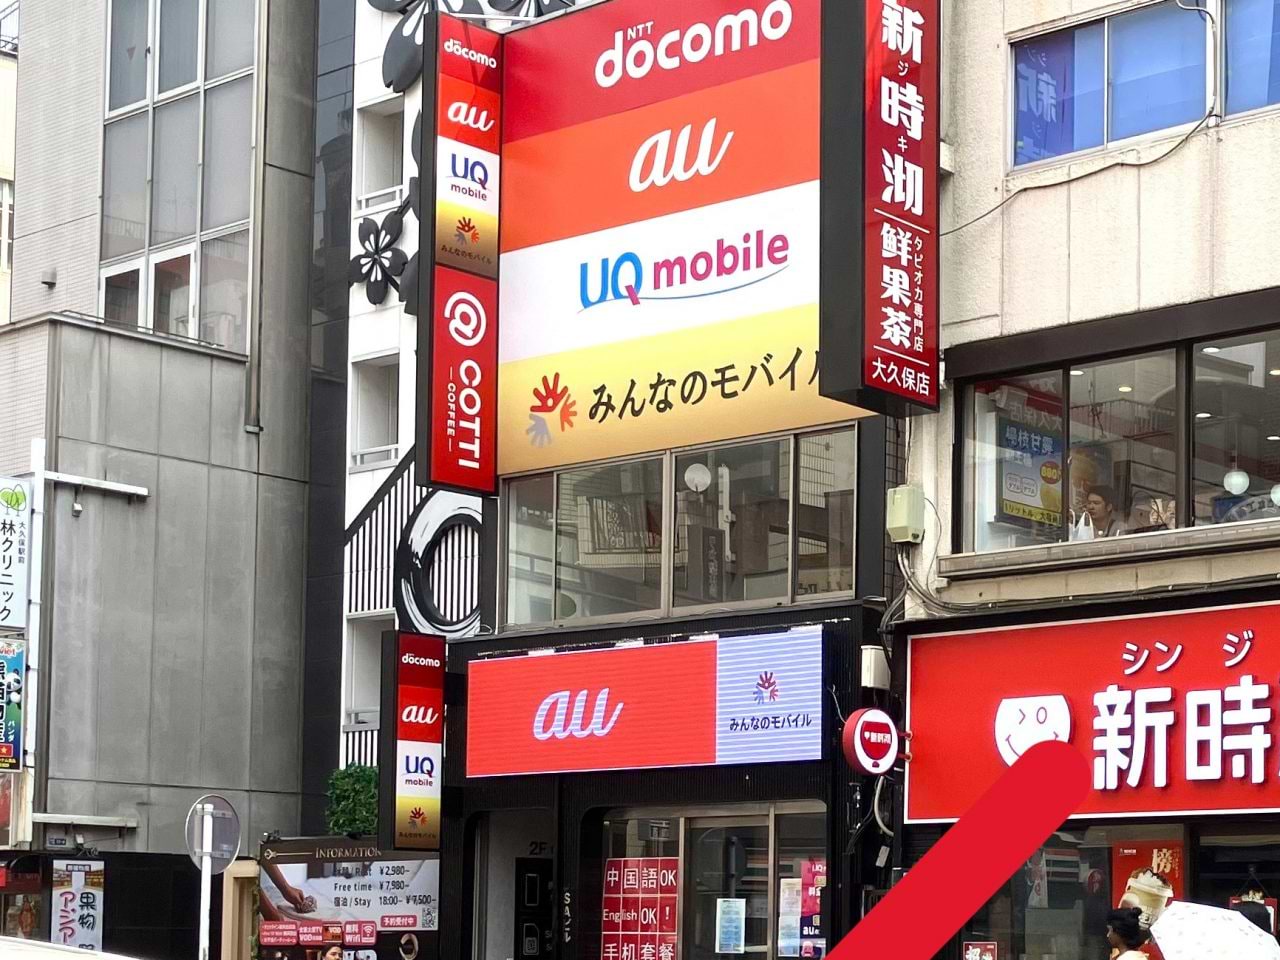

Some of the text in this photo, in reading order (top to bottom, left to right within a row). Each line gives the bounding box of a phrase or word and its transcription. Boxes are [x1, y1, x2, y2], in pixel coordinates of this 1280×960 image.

[594, 0, 793, 88] docomo
[627, 20, 654, 41] NTT
[444, 38, 497, 69] docomo
[447, 100, 495, 132] au
[628, 117, 734, 193] au
[451, 153, 489, 190] UQ
[450, 183, 487, 202] mobile
[579, 230, 789, 307] UQ mobile
[880, 222, 913, 350] 鮮果茶
[912, 235, 925, 354] タピオカ専門店
[872, 355, 931, 397] 大久保店
[447, 383, 457, 437] COFFEE
[459, 359, 482, 469] COTTI
[0, 519, 16, 621] 林クリニック
[401, 653, 441, 667] docomo
[1122, 641, 1183, 675] シン
[1222, 629, 1254, 667] ジ
[402, 705, 439, 724] au
[532, 687, 625, 741] au
[729, 713, 812, 732] みんなのモバイル
[405, 755, 435, 778] UQ
[404, 778, 433, 787] mobile
[315, 847, 382, 859] INFORMATION
[334, 882, 351, 891] Free
[354, 881, 373, 891] time
[607, 867, 677, 889] 中国語OK
[354, 896, 371, 908] Stay
[603, 911, 637, 923] English
